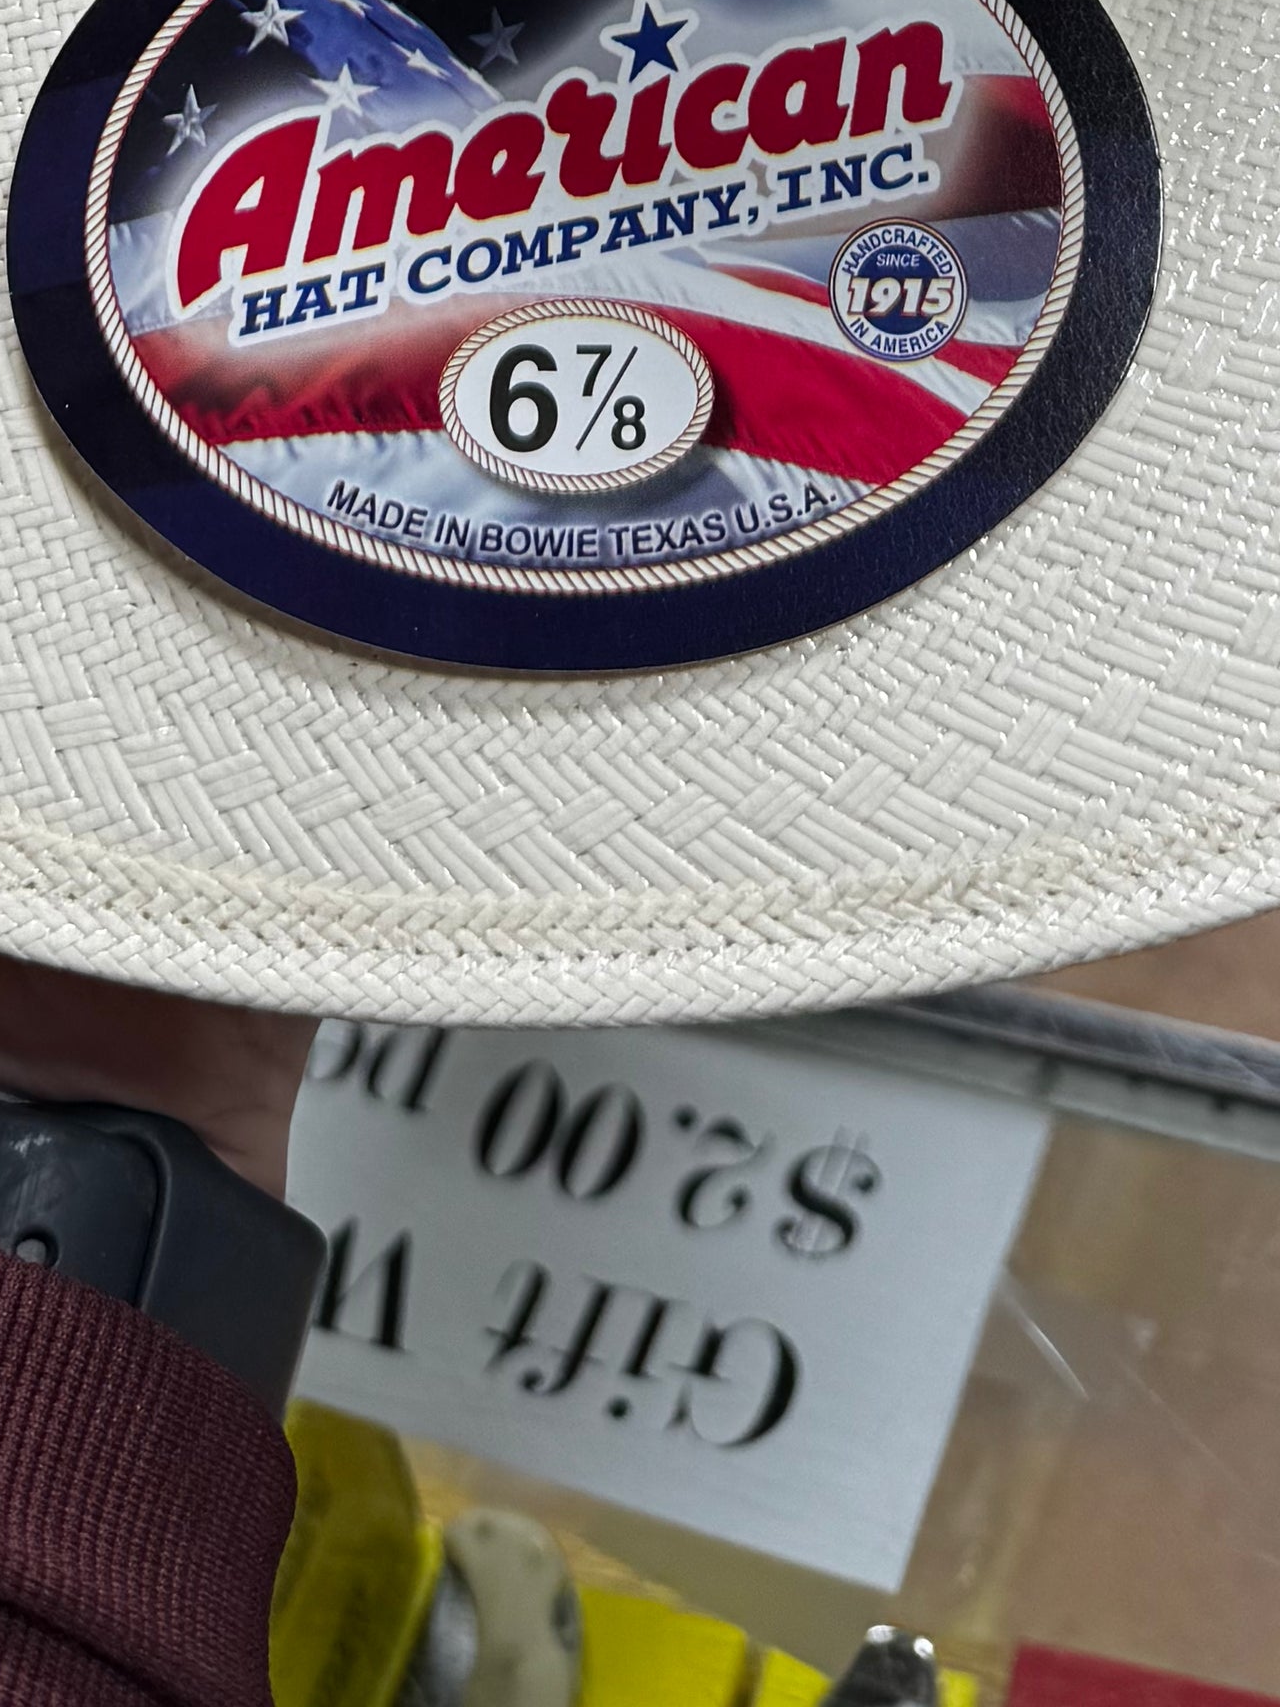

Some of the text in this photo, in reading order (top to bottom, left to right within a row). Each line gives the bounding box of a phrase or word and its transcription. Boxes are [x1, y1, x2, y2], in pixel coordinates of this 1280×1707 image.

[176, 20, 951, 309] American
[240, 142, 931, 338] HAT COMPANY, INC.
[842, 228, 952, 275] HANDCRAFTED
[876, 254, 921, 267] SINCE
[847, 276, 956, 317] 1915
[850, 318, 949, 353] IN AMERICA
[326, 479, 839, 559] MADE IN BOWIE TEXAS U.S.A.
[471, 1059, 883, 1263] $2.00
[482, 1257, 801, 1448] Gift
